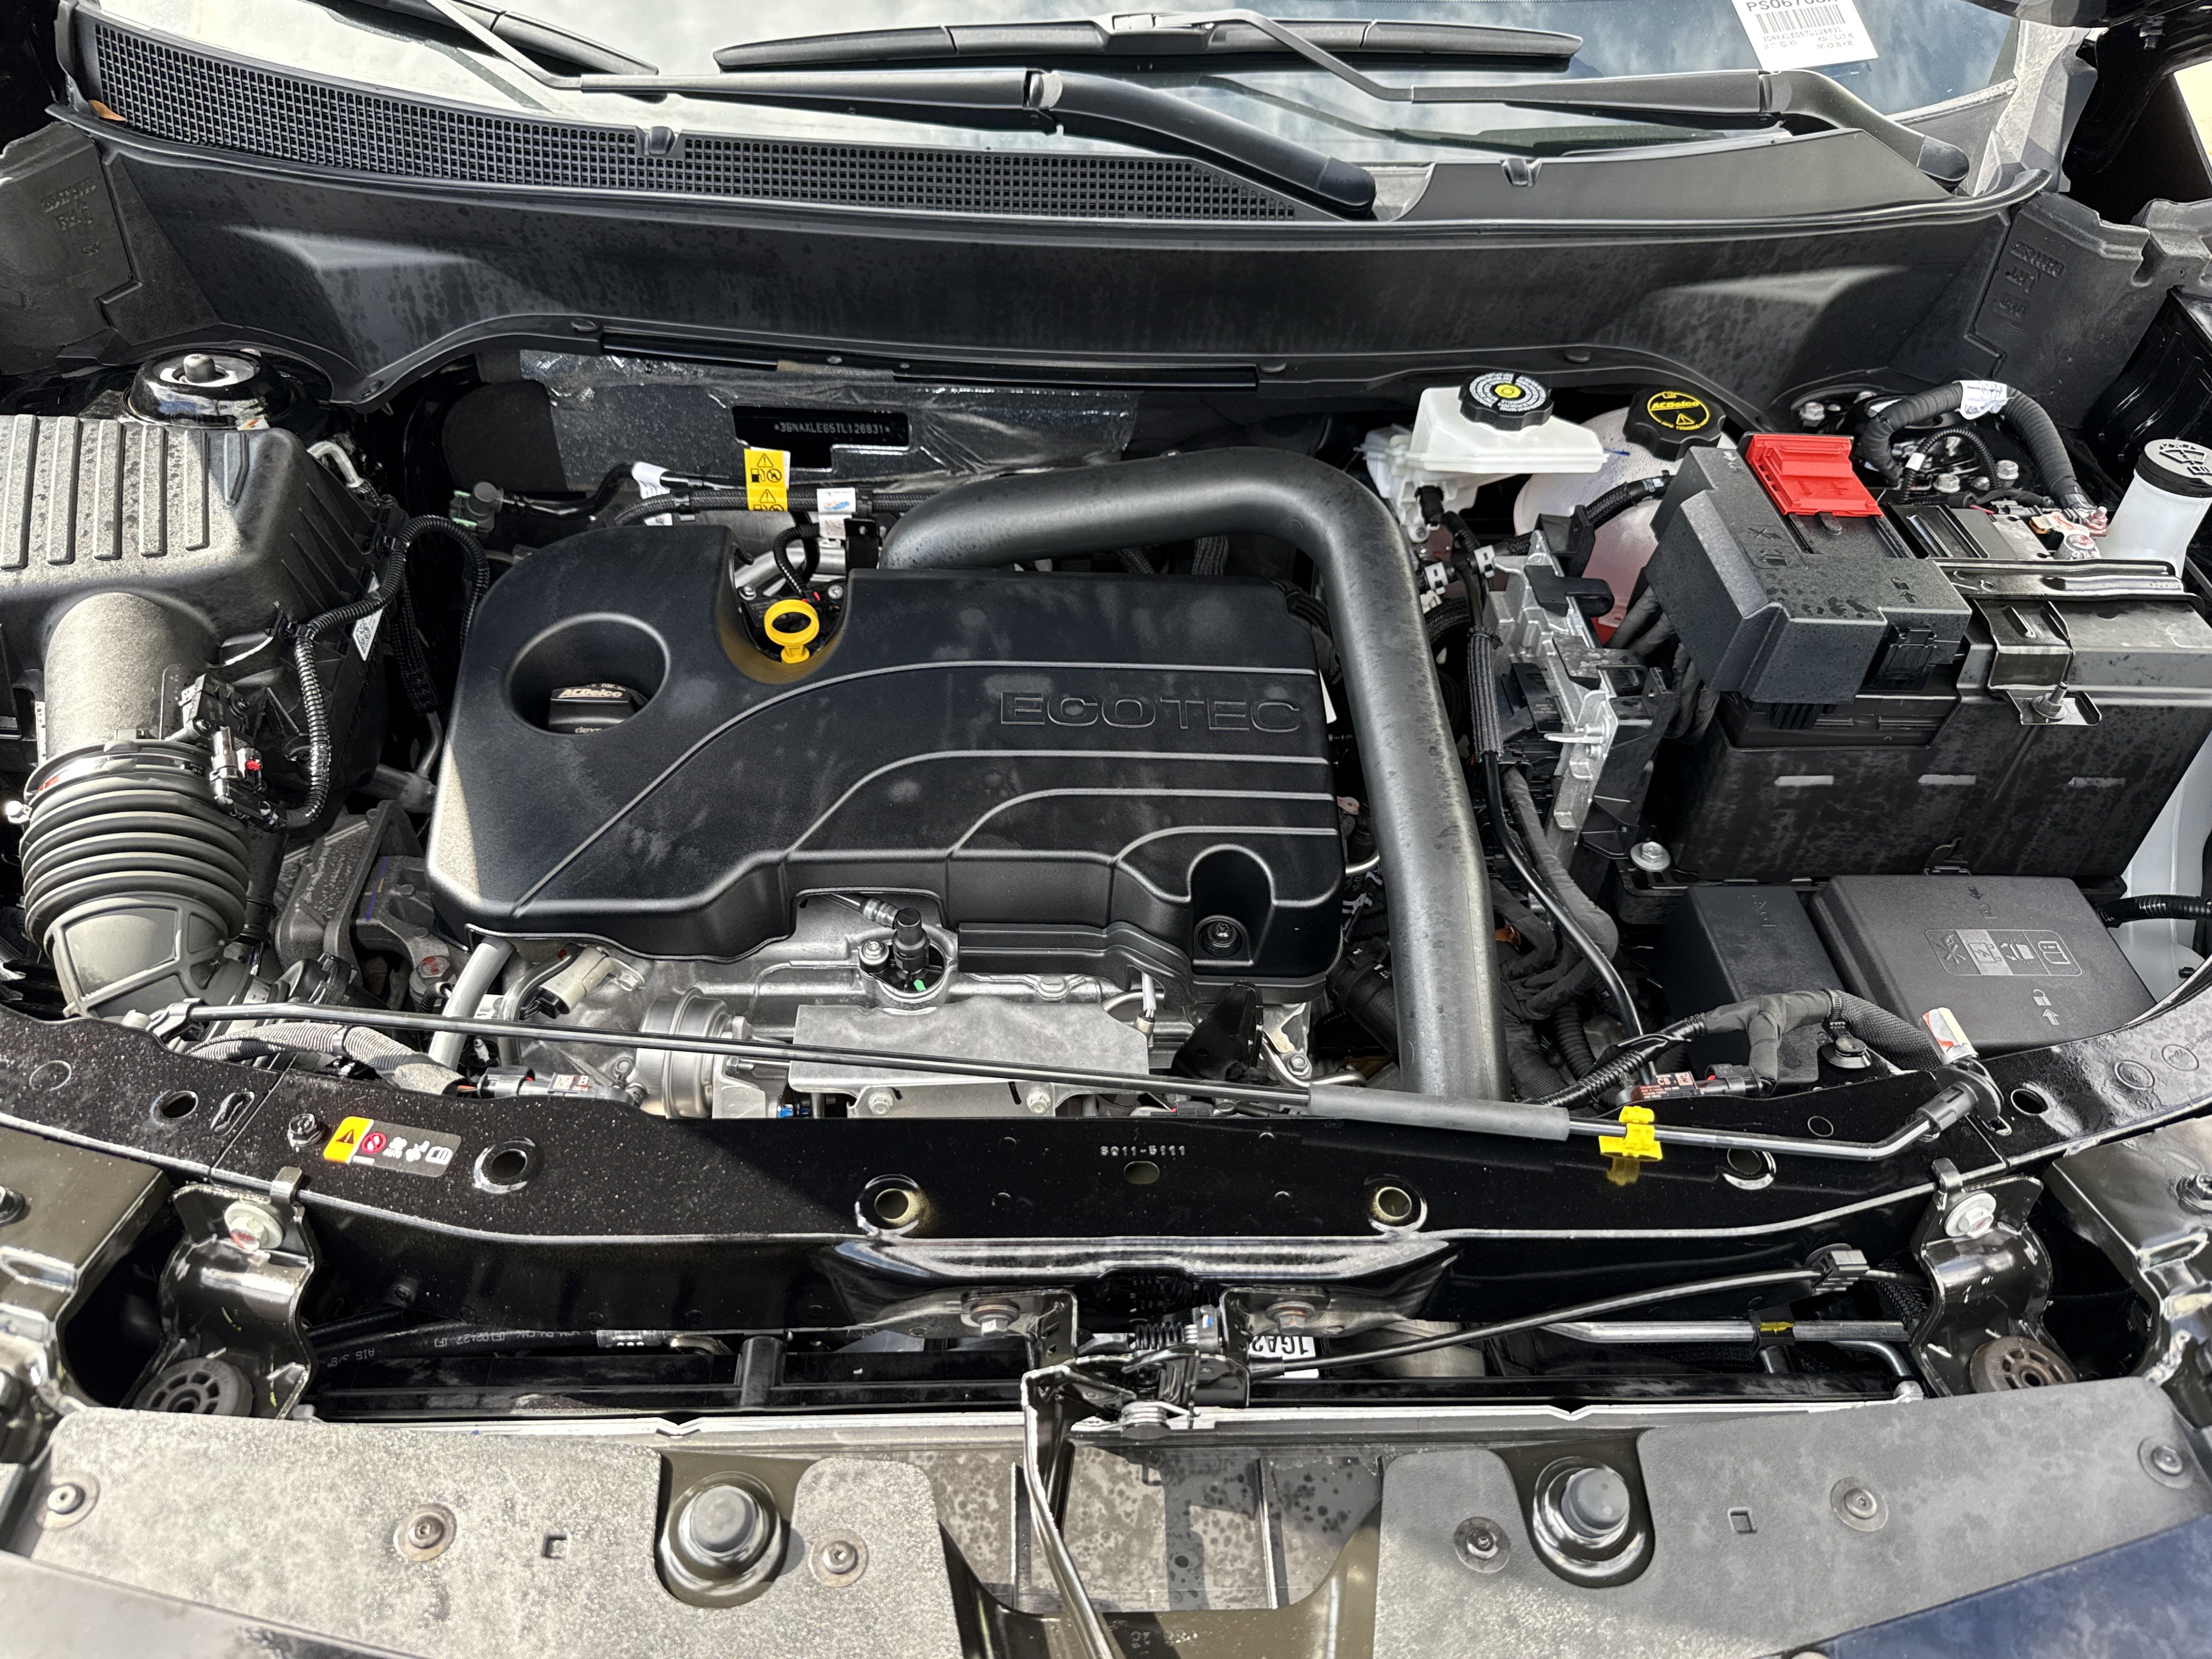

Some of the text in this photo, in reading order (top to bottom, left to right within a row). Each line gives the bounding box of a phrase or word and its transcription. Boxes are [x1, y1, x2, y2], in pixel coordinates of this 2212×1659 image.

[1651, 400, 1700, 410] ACDelco
[558, 688, 623, 699] ACDelco
[1000, 692, 1300, 733] ECOTEC
[1657, 1077, 1671, 1086] CB
